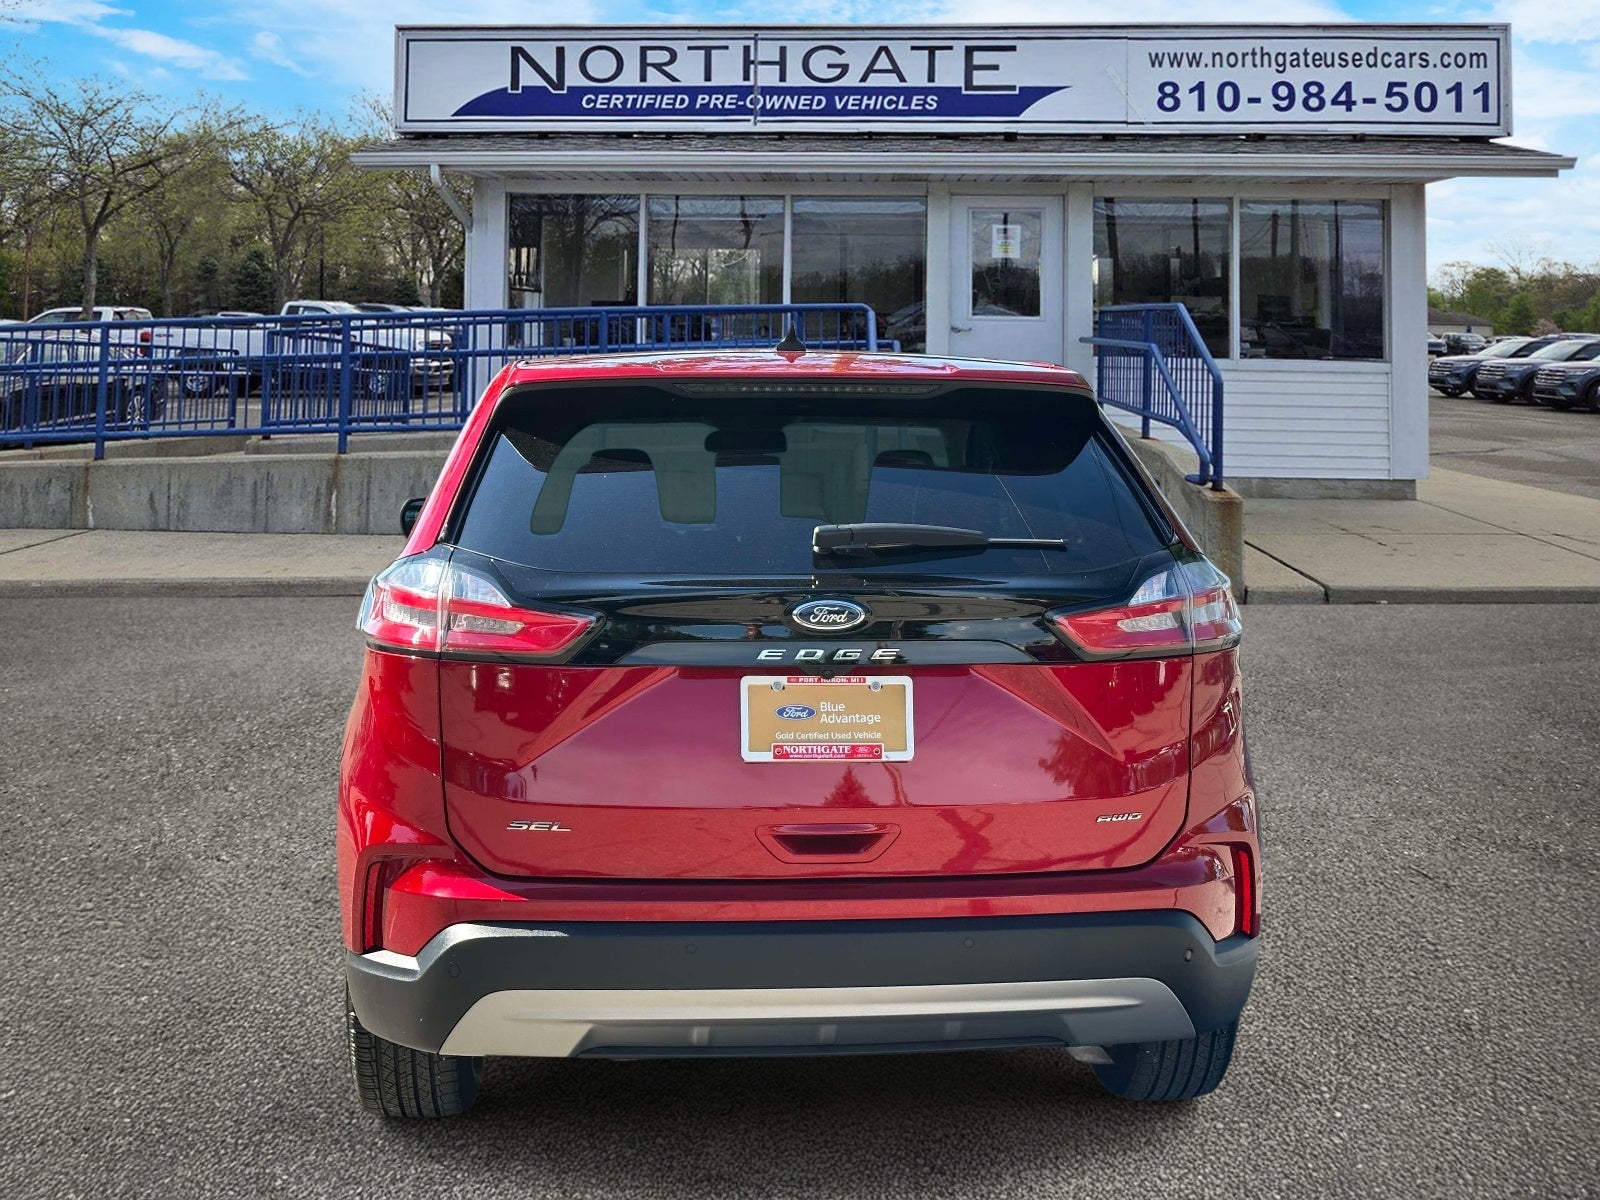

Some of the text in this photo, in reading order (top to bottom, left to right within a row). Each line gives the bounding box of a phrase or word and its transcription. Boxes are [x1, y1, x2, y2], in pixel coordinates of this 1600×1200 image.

[1148, 45, 1489, 74] www.northgateusedcars.com
[509, 45, 1018, 94] NORTHGATE
[581, 93, 938, 110] CERTIFIED PRE-OWNED VEHICLES
[1156, 80, 1491, 113] 810-984-5011
[809, 606, 849, 623] Ford
[756, 649, 901, 660] EDGE
[782, 706, 808, 719] Ford
[820, 702, 846, 712] Blue
[820, 713, 881, 725] Advantage
[853, 731, 882, 739] Vehicle
[782, 745, 852, 754] NORTHGATE
[1096, 812, 1142, 823] AWD
[506, 820, 572, 832] SEL
